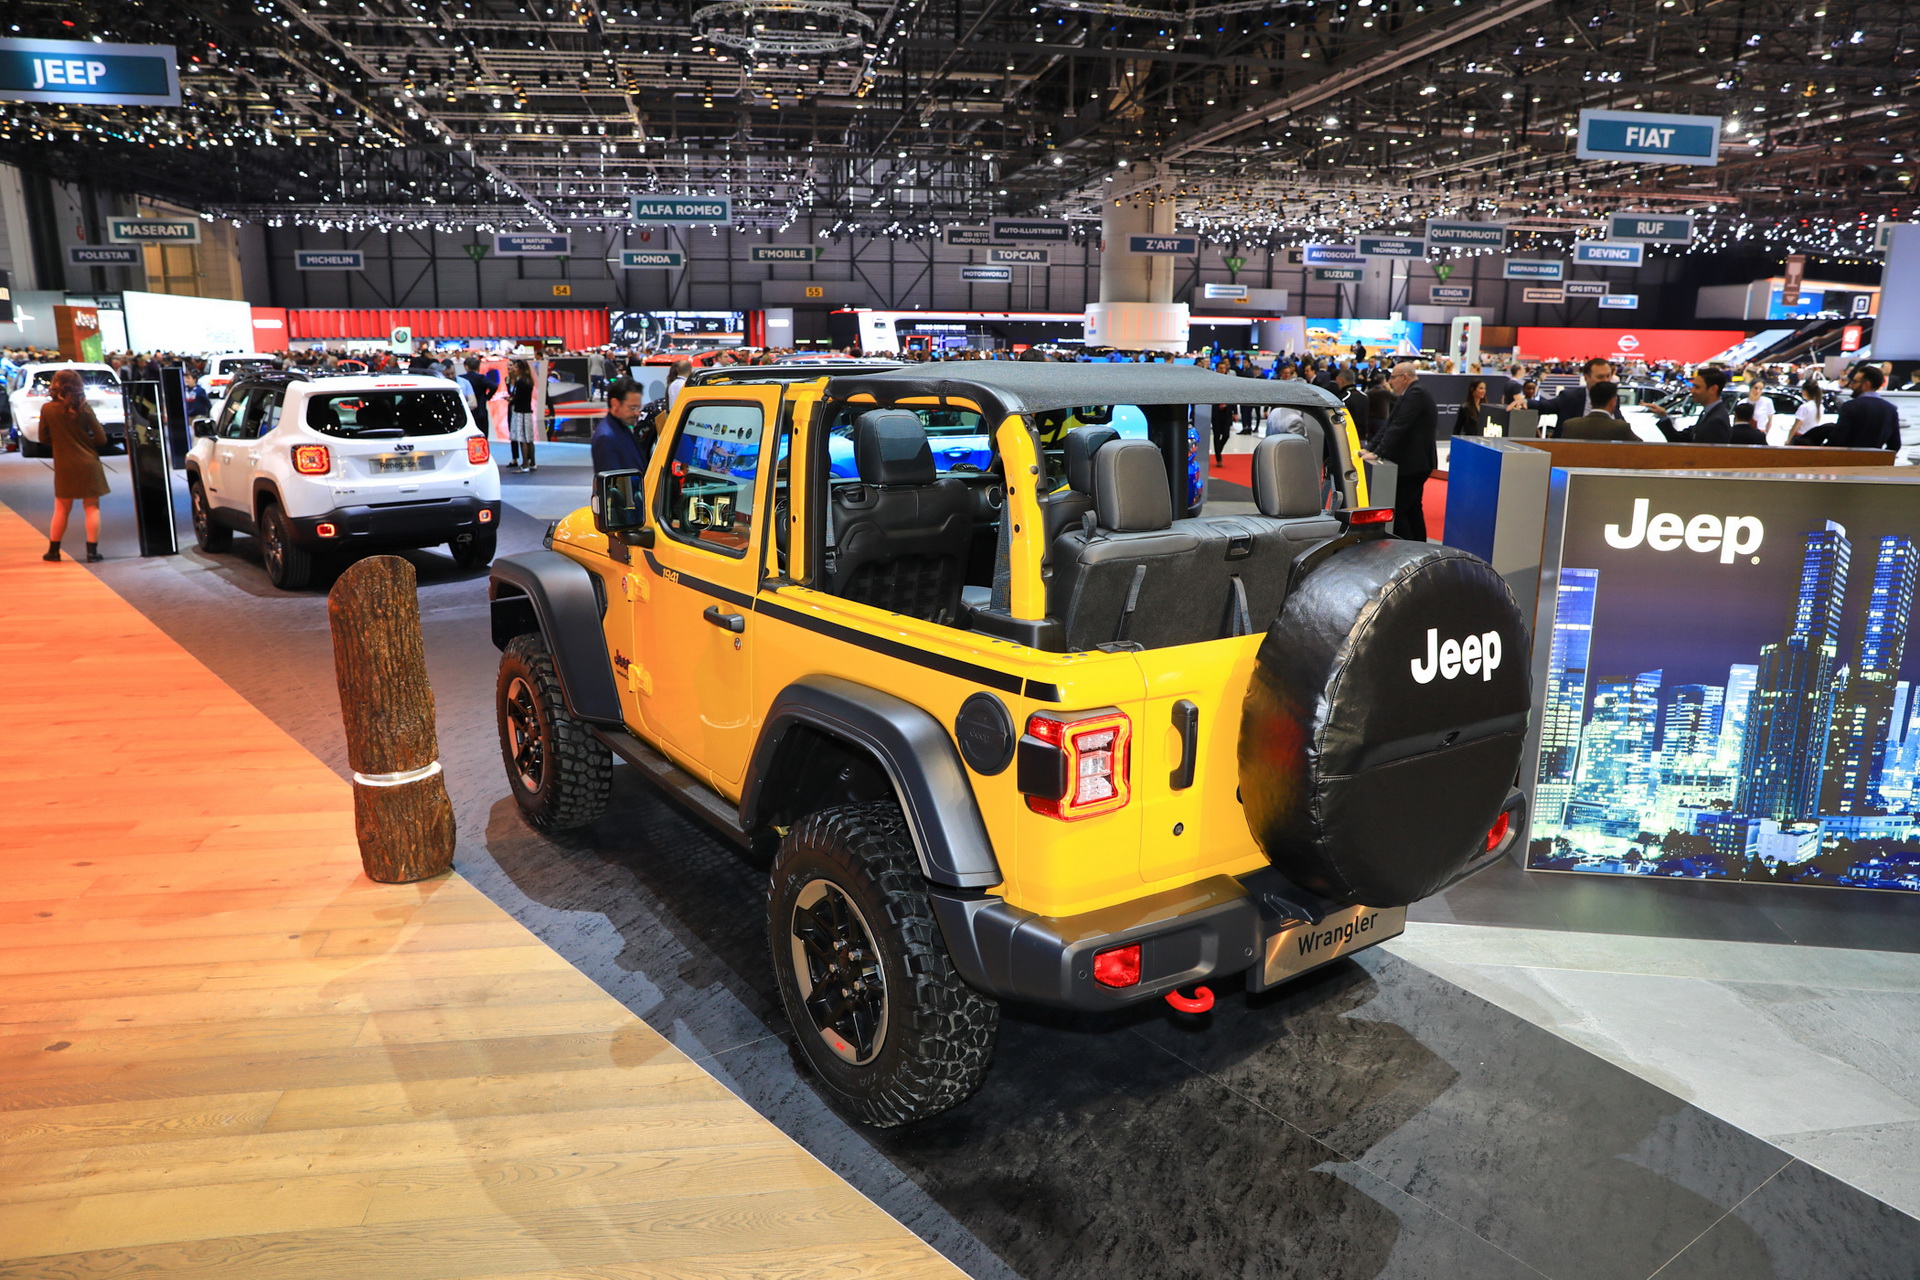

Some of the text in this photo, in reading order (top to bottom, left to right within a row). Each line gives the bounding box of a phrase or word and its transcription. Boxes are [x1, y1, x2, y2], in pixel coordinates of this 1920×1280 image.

[33, 58, 107, 90] JEEP
[1625, 126, 1676, 149] FIAT
[640, 204, 723, 216] ALFA ROMEO
[119, 224, 190, 237] MASERATI
[999, 226, 1063, 235] AUTO-ILLUSTRIERTE
[1636, 221, 1664, 235] RUF
[1431, 228, 1501, 240] QUATTRORUOTE
[1146, 239, 1180, 251] Z'ART
[79, 251, 130, 260] POLESTAR
[758, 249, 806, 259] E'MOBILE
[998, 250, 1041, 260] TOPCAR
[1311, 250, 1358, 260] AUTOSCOUT
[1372, 247, 1411, 255] TECHNOLOGY
[1588, 248, 1630, 259] DEVINCI
[306, 255, 354, 265] MICHELIN
[633, 254, 671, 264] HONDA
[963, 269, 1008, 278] MOTORWORLD
[1323, 270, 1354, 279] SUZUKI
[555, 286, 568, 295] 54
[808, 287, 821, 296] 55
[394, 444, 415, 453] Jeep
[380, 459, 416, 470] Renegade
[1604, 498, 1764, 565] Jeep
[662, 568, 680, 584] 1941
[1410, 627, 1502, 685] Jeep
[1298, 912, 1379, 957] Wrangler
